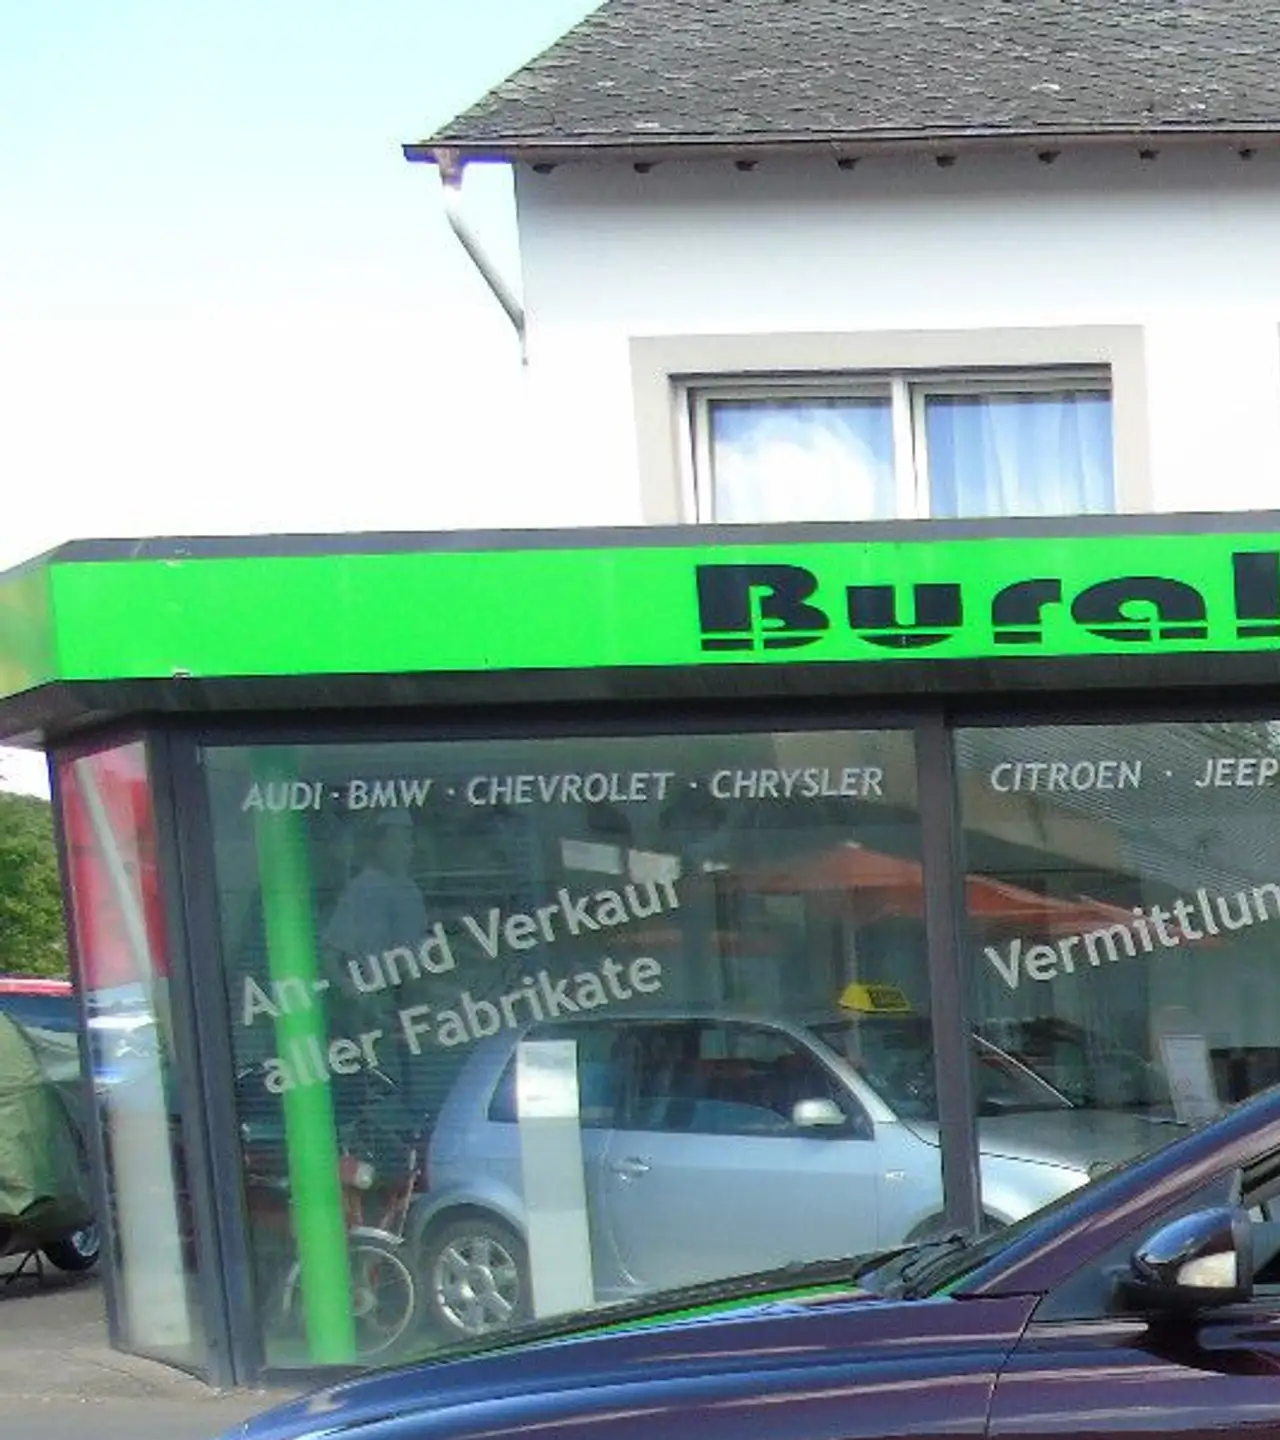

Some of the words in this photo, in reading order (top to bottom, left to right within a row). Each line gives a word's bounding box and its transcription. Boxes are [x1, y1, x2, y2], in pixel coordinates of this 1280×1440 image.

[242, 782, 323, 812] AUDI
[348, 778, 431, 809] BMW
[467, 772, 675, 806] CHEVROLET
[710, 767, 884, 800] CHRYSLER
[990, 760, 1142, 792] CITROEN
[1195, 757, 1280, 788] JEEP
[240, 976, 331, 1026] An-
[346, 922, 458, 994] und
[462, 878, 683, 963] Verkauf
[262, 1028, 385, 1095] aller
[398, 956, 663, 1055] Fabrikate
